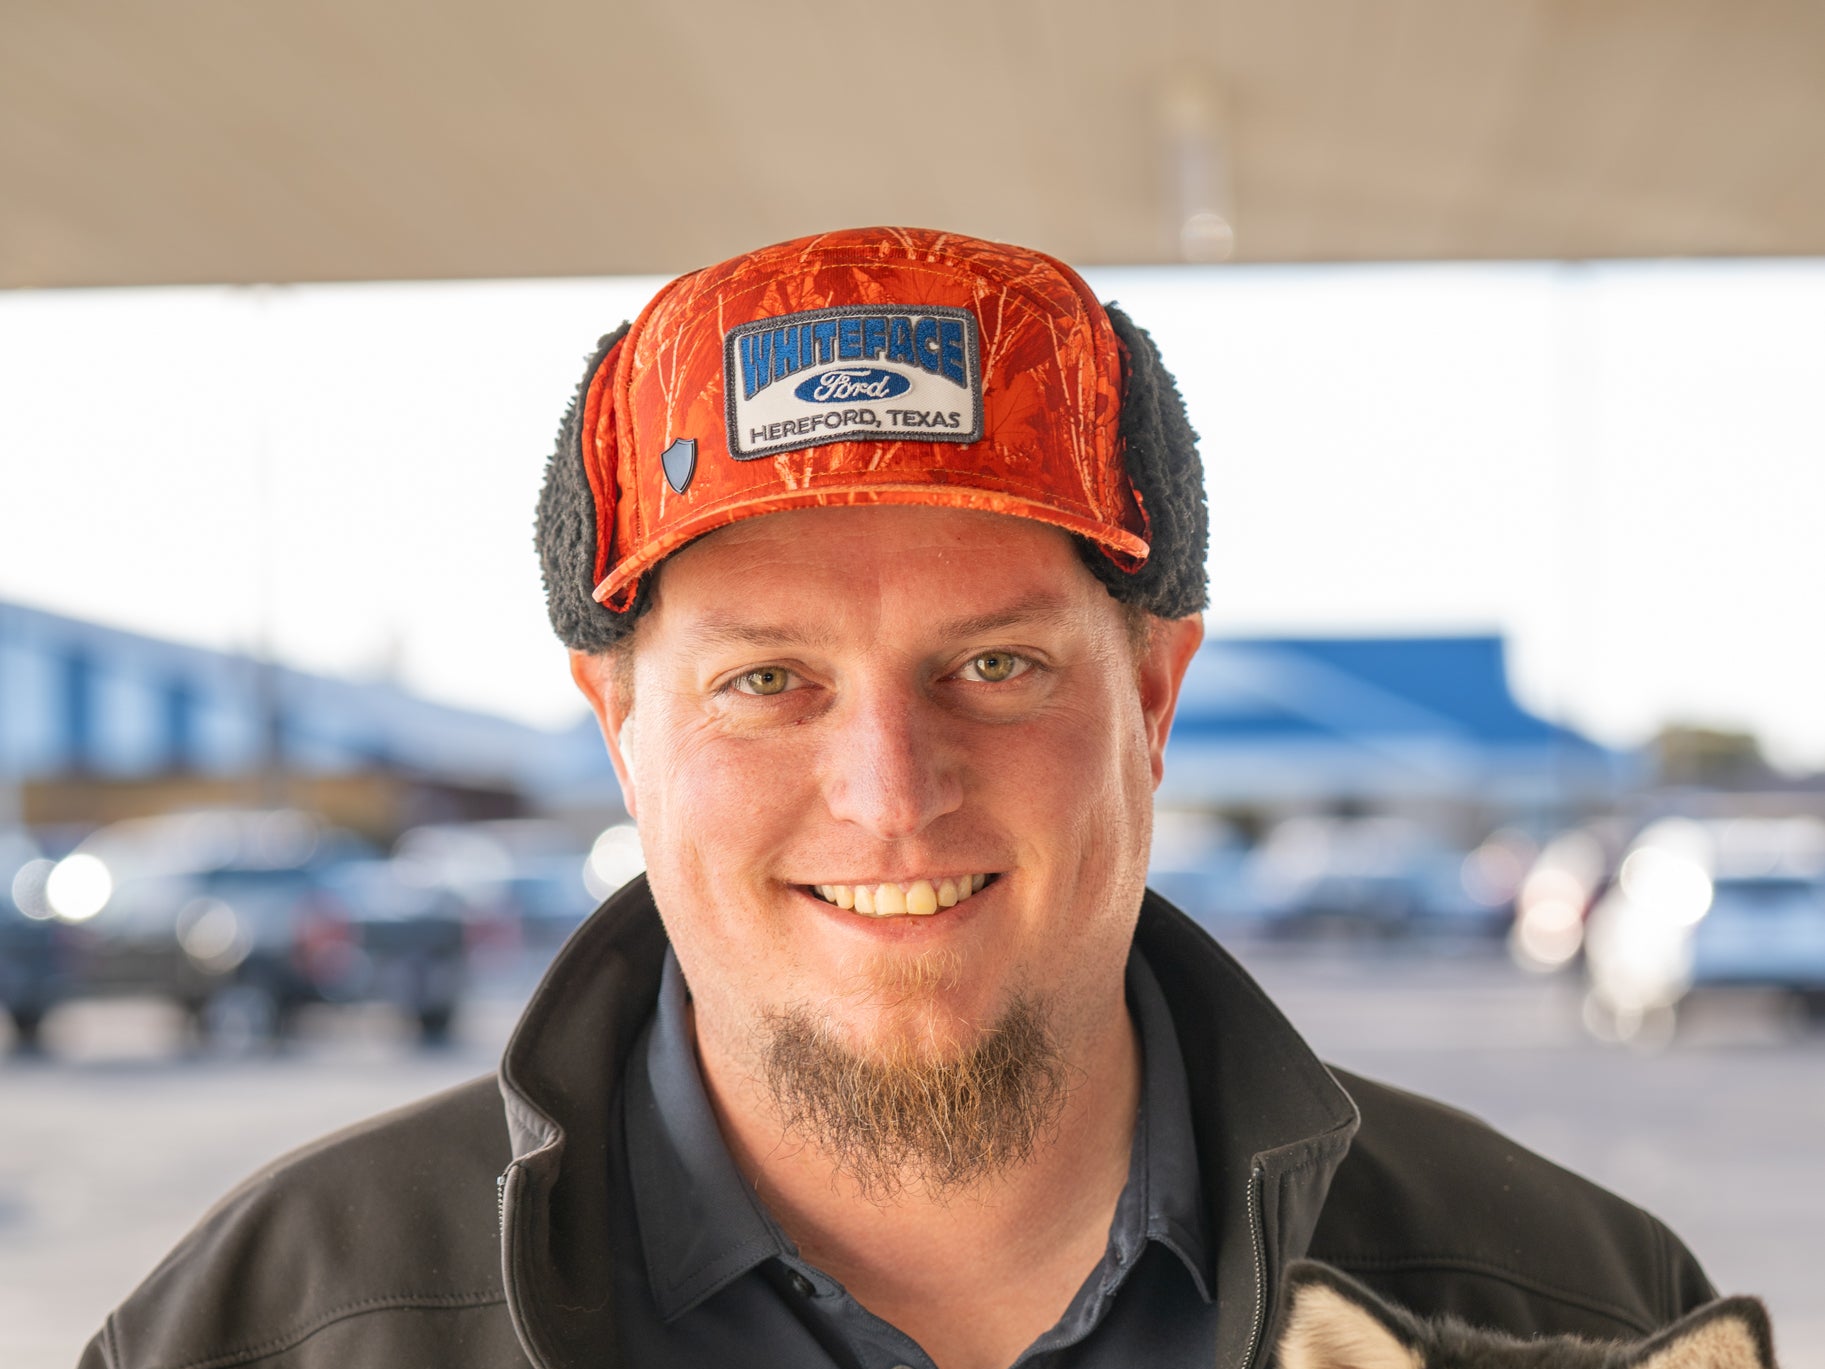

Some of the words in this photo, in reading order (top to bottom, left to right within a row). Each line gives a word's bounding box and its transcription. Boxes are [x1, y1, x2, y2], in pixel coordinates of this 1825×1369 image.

[739, 316, 968, 401] WHITEFACE
[814, 370, 890, 401] Ford
[750, 409, 882, 444] HEREFORD,
[886, 410, 961, 429] TEXAS
